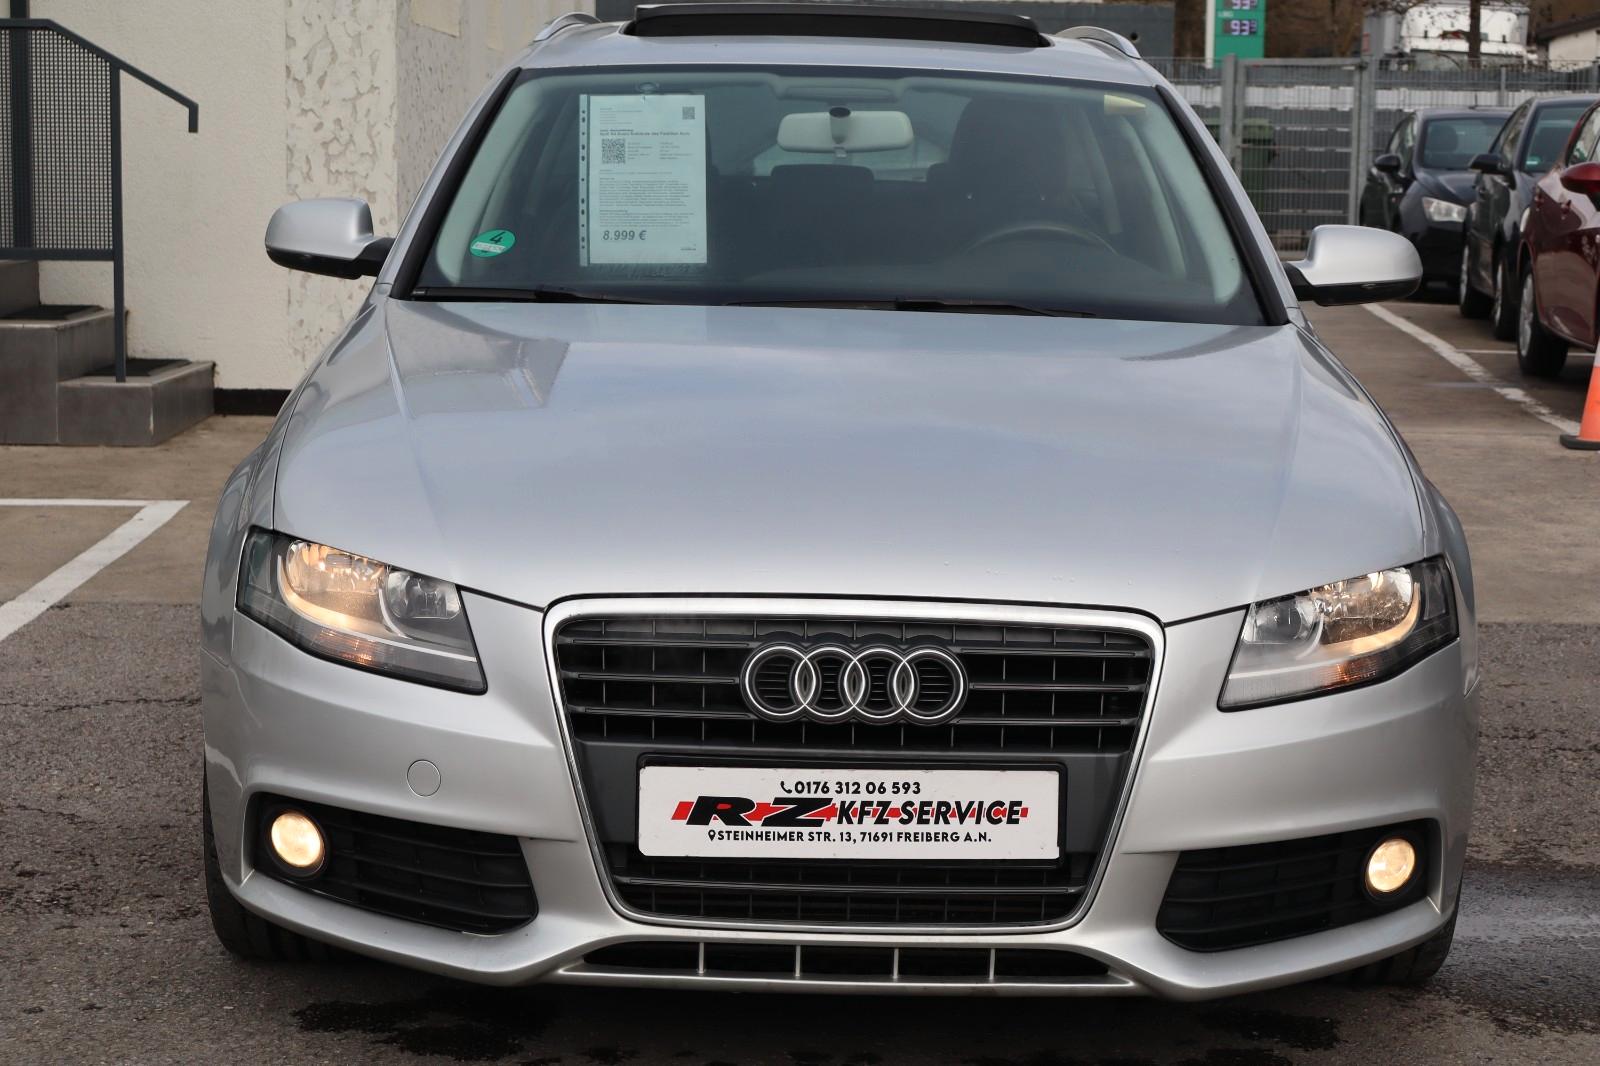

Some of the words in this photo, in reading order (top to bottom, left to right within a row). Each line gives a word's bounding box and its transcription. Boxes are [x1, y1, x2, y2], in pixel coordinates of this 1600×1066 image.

[489, 231, 506, 244] 4
[602, 230, 635, 241] 8.999
[639, 230, 647, 241] €
[794, 781, 830, 794] 0176
[835, 781, 861, 795] 312
[865, 781, 887, 795] 06
[891, 781, 921, 795] 593
[686, 795, 834, 827] RZ
[717, 830, 804, 842] STEINHEIMER
[807, 831, 836, 843] STR.
[839, 831, 857, 844] 13,
[860, 831, 893, 843] 71691
[896, 831, 960, 843] FREIBERG
[963, 831, 992, 843] A.N.
